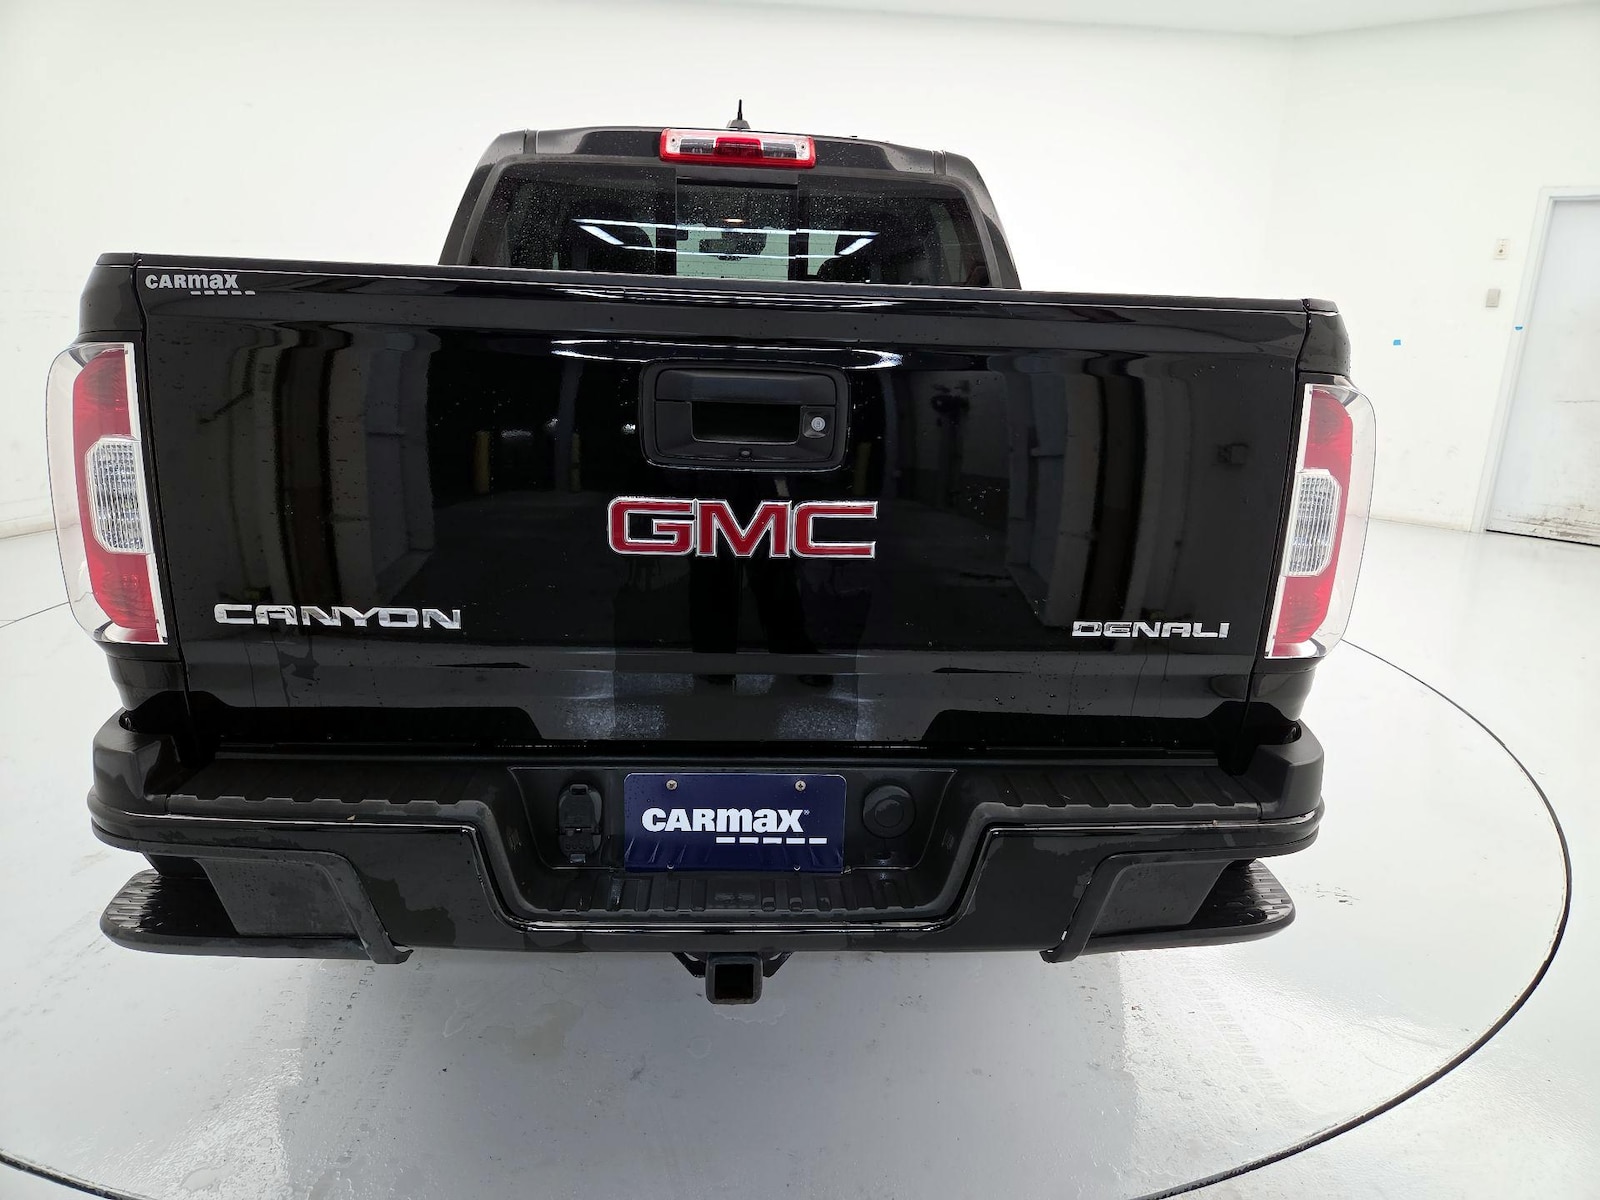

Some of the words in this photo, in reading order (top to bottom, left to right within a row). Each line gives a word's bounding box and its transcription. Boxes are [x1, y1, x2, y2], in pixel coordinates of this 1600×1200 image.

[608, 498, 878, 558] GMC
[213, 604, 462, 629] CANYON
[1071, 621, 1231, 639] DENALI
